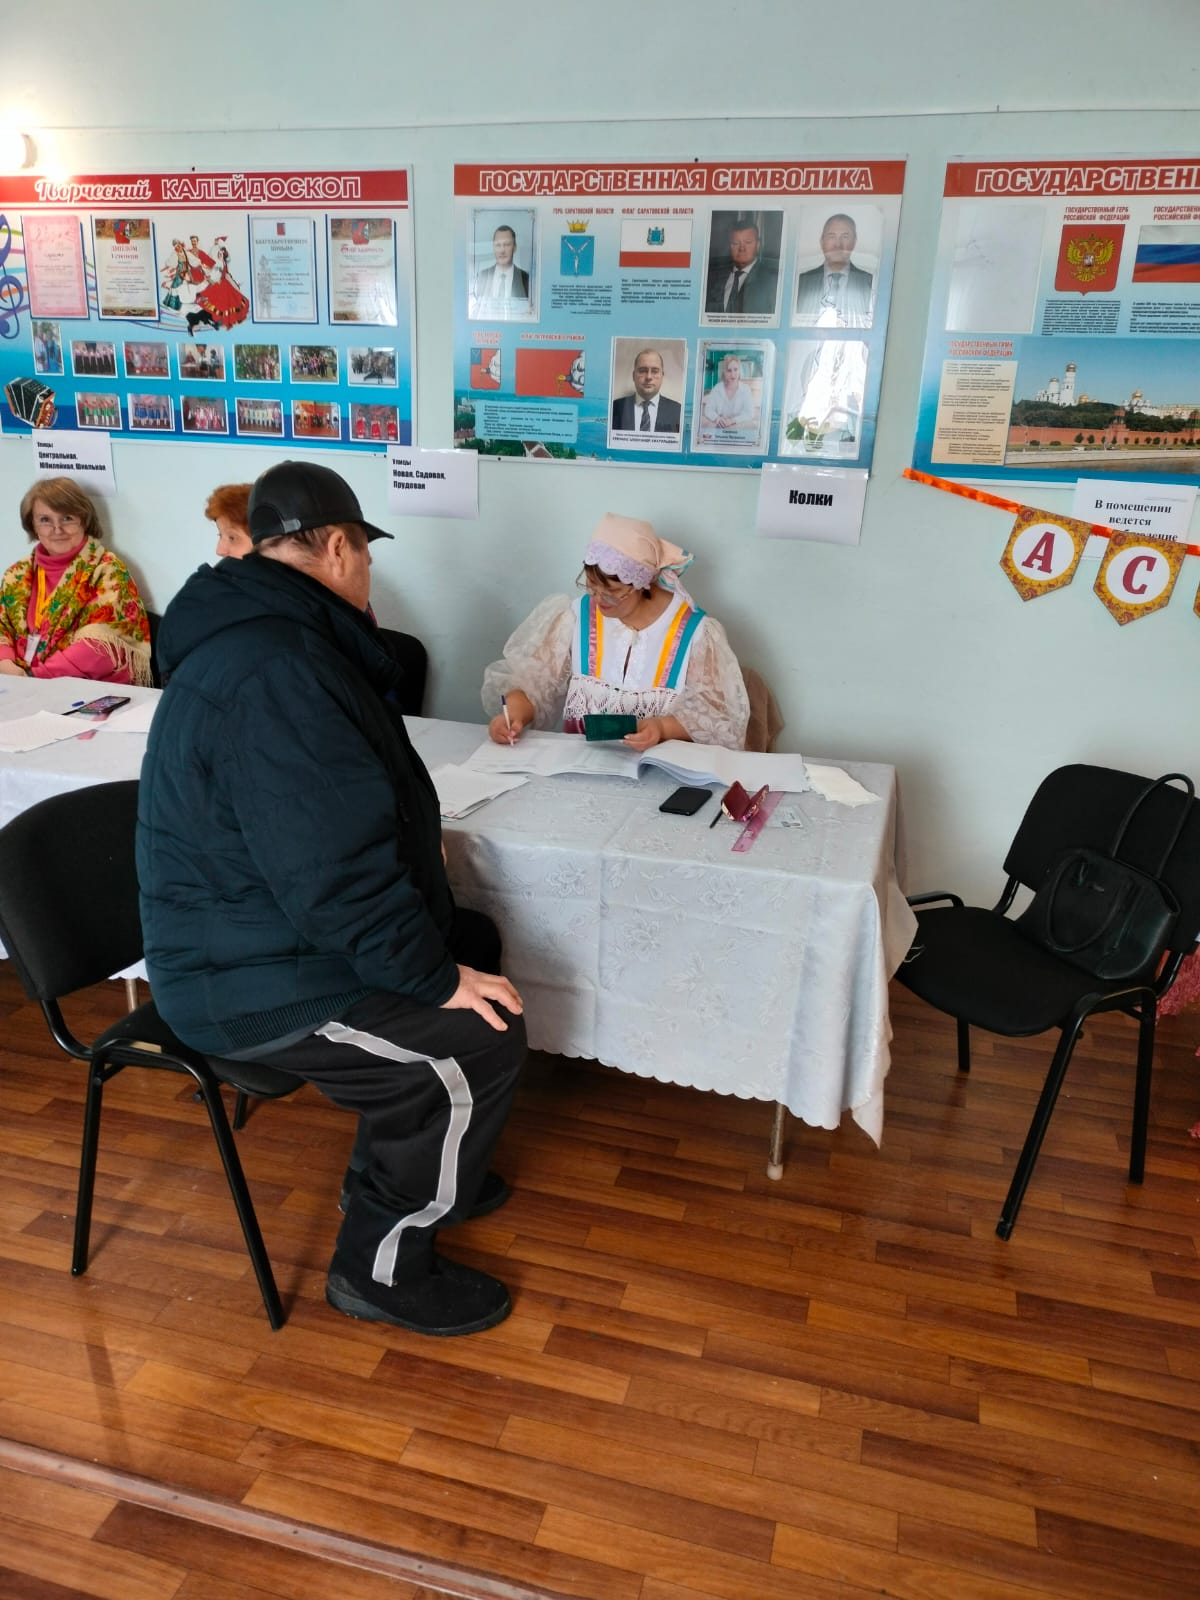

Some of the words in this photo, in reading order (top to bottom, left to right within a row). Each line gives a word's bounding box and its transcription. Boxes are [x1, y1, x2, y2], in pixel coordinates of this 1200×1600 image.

[479, 167, 706, 195] ГОСУДАРСТВЕННАЯ
[711, 167, 874, 191] СИМВОЛИКА
[34, 178, 151, 203] Творческий
[161, 174, 361, 202] КАЛЕЙДОСКОП
[637, 207, 670, 215] САРАТОВСКОЙ
[415, 470, 446, 480] Садовая,
[393, 481, 426, 490] Прудовая
[789, 489, 834, 507] Колки
[1094, 499, 1103, 509] В
[1106, 502, 1172, 513] помещении
[1109, 516, 1152, 526] ведется
[1021, 531, 1056, 574] А
[1122, 555, 1157, 595] С
